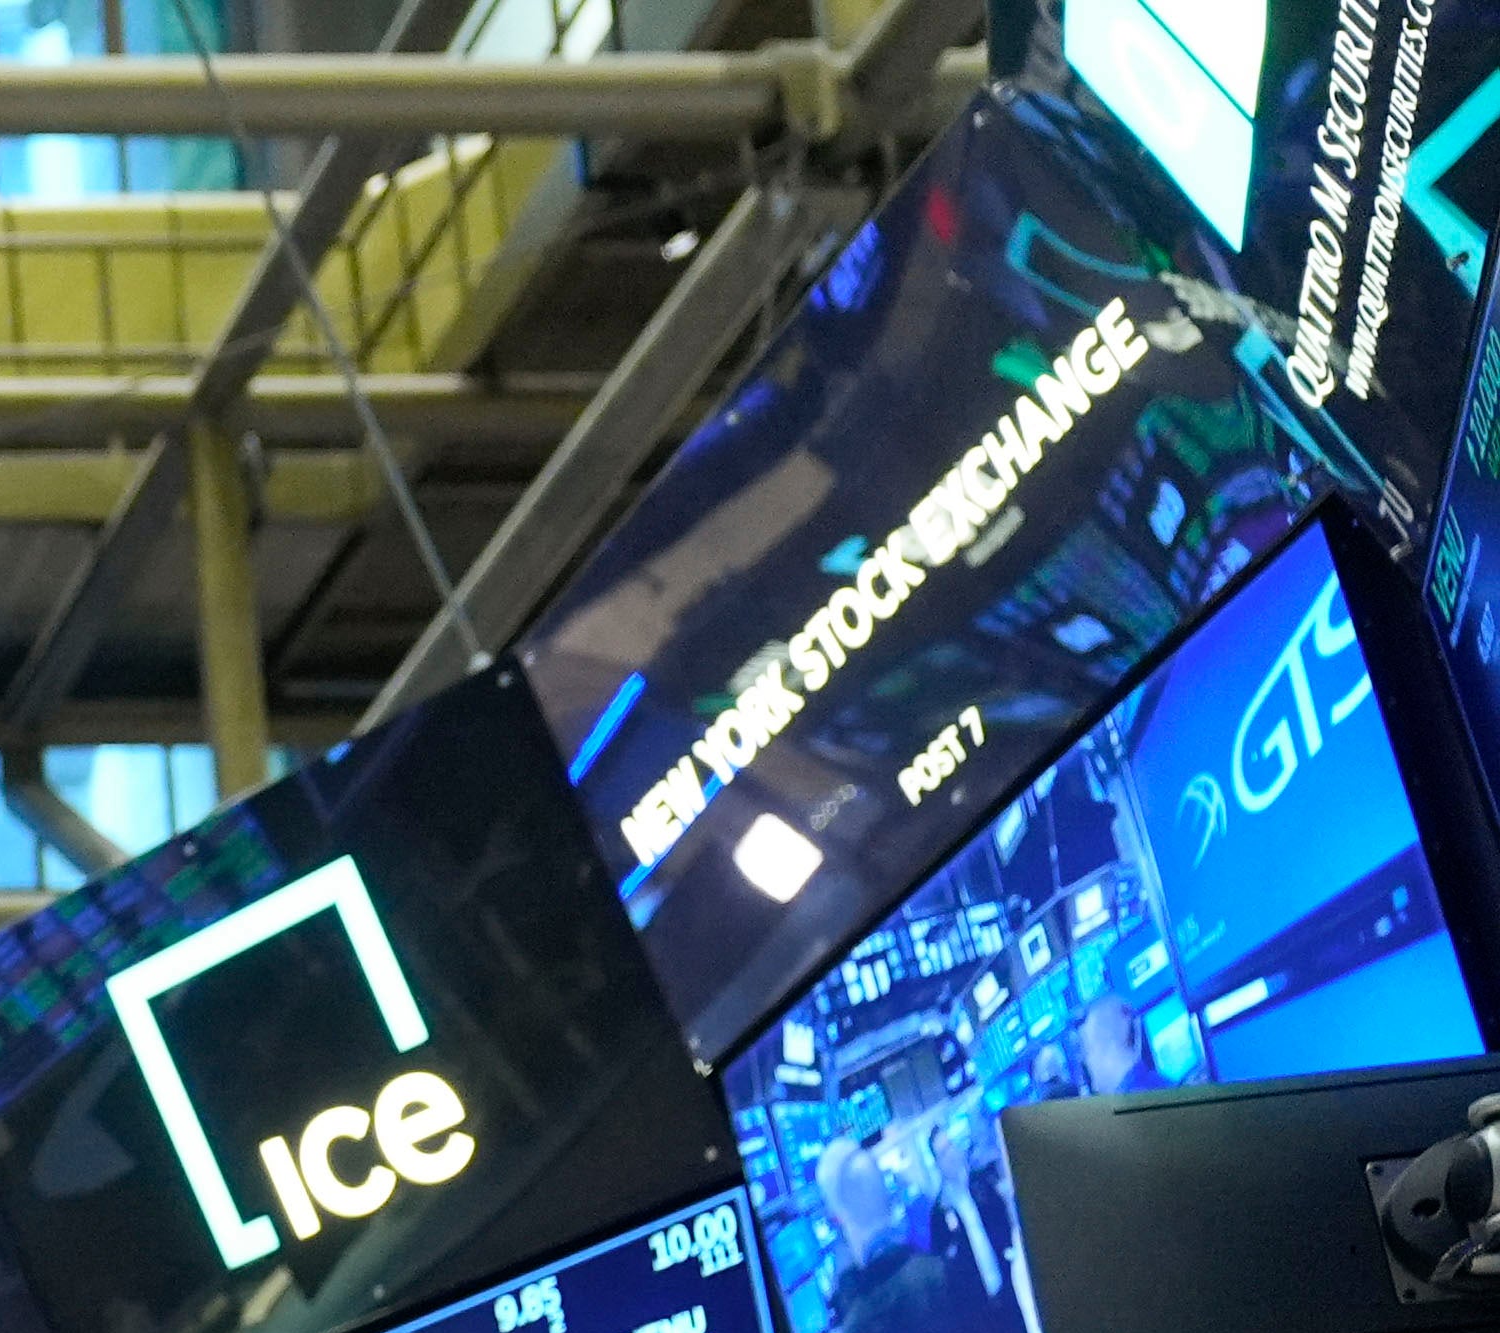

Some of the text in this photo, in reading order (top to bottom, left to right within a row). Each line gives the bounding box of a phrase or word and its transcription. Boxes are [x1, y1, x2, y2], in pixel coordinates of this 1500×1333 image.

[1310, 163, 1351, 234] M
[1286, 220, 1346, 409] QUATTRO
[620, 298, 1149, 867] NEW YORK STOCK EXCHANGE
[898, 705, 984, 806] POST 7
[649, 1204, 738, 1271] 10.00
[494, 1276, 562, 1333] 9.85
